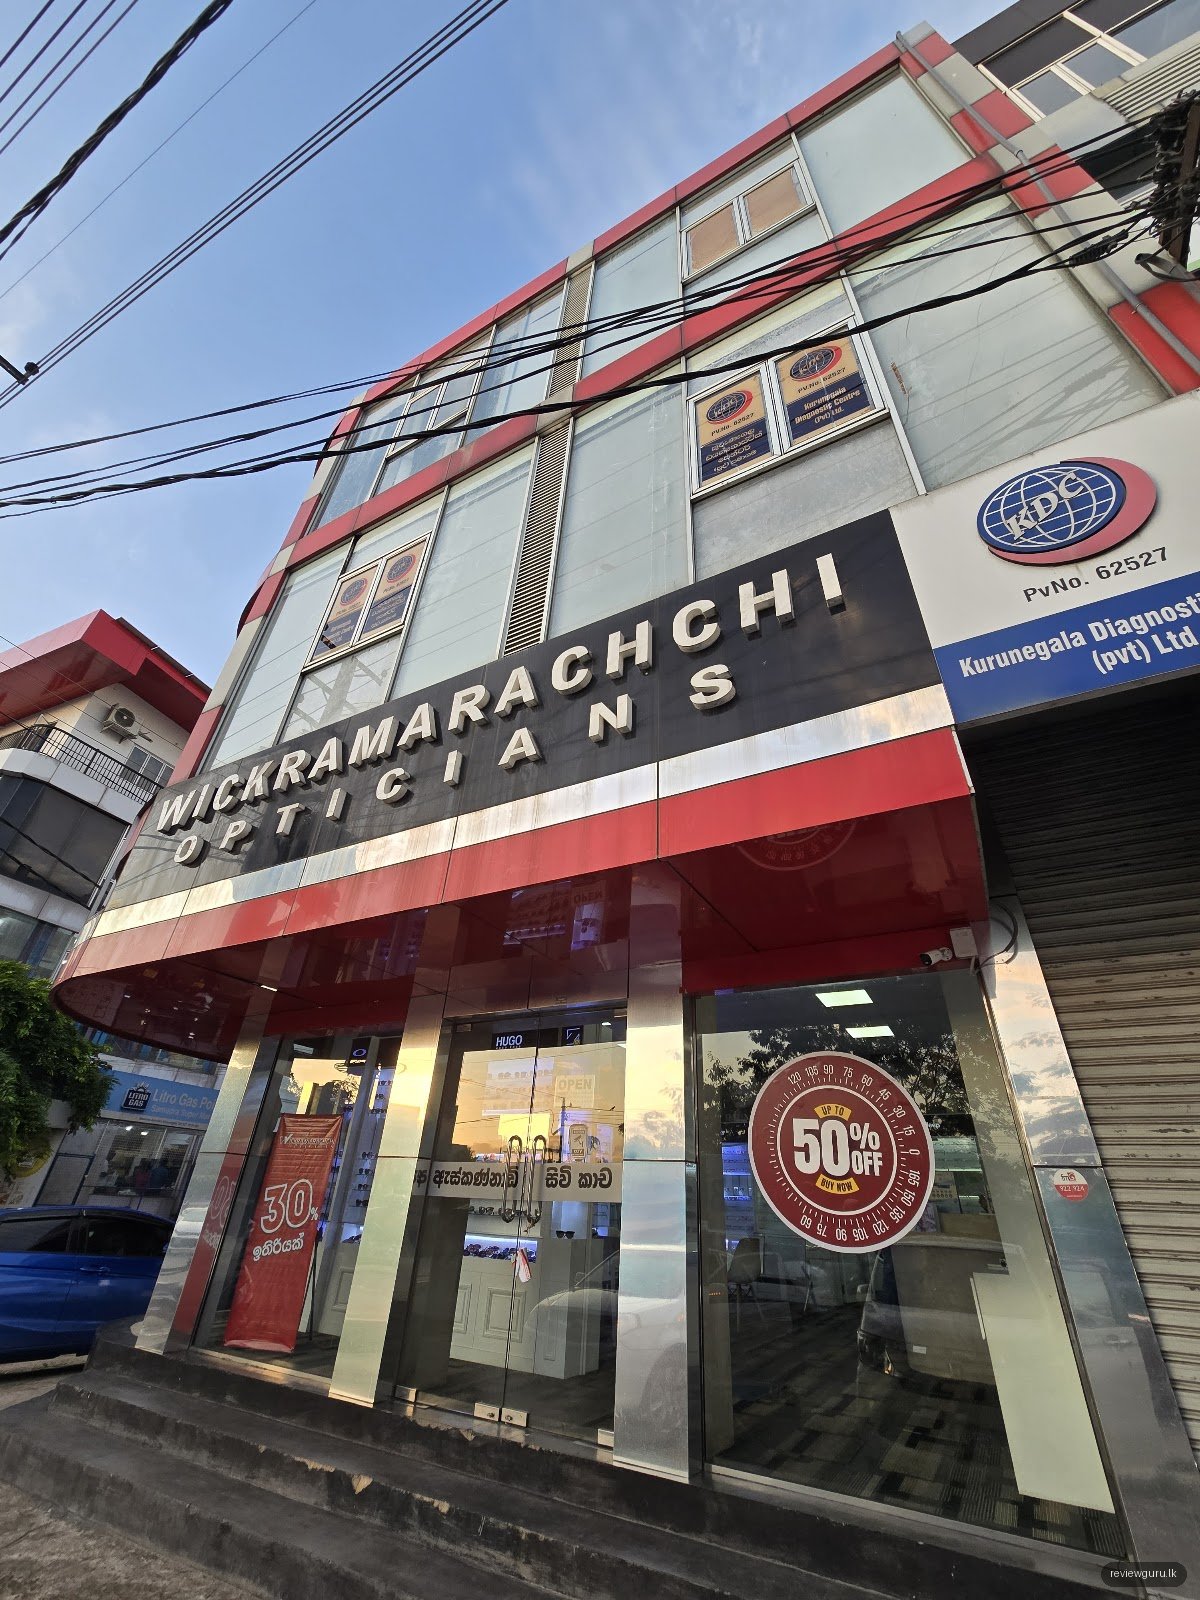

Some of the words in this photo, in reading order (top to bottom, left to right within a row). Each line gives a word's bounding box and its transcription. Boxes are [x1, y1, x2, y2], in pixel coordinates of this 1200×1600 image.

[822, 367, 847, 383] 62527
[803, 387, 847, 411] Kurunegala
[794, 403, 833, 425] Diagnostic
[833, 389, 861, 407] Centre
[1005, 470, 1086, 541] KDC
[1023, 574, 1090, 603] PvNo.
[1096, 546, 1168, 581] 62527
[958, 630, 1088, 679] Kurunegala
[1092, 638, 1152, 675] (pvt)
[1150, 625, 1199, 655] Ltd
[156, 552, 847, 835] WICKRAMARACHCHI
[173, 663, 737, 867] OPTICIANS
[495, 1034, 523, 1047] HUGO
[805, 1064, 819, 1077] 105
[823, 1064, 834, 1075] 90
[843, 1066, 854, 1078] 75
[559, 1078, 592, 1091] OPEN
[788, 1071, 802, 1085] 120
[861, 1074, 873, 1087] 60
[128, 1092, 149, 1101] LITRO
[152, 1088, 177, 1104] Litro
[178, 1093, 198, 1108] Gas
[878, 1088, 892, 1101] 45
[128, 1099, 144, 1107] GAS
[821, 1106, 833, 1116] UP
[834, 1106, 845, 1116] TO
[892, 1105, 906, 1119] 30
[902, 1124, 916, 1136] 15
[909, 1148, 921, 1156] 0
[851, 1150, 883, 1177] OFF
[820, 1179, 835, 1191] BUY
[836, 1181, 853, 1192] NOW
[908, 1170, 921, 1188] 165
[900, 1188, 916, 1207] 150
[800, 1214, 812, 1229] 60
[889, 1205, 906, 1223] 135
[816, 1223, 828, 1238] 75
[836, 1228, 848, 1241] 90
[853, 1227, 869, 1242] 105
[873, 1221, 890, 1236] 120
